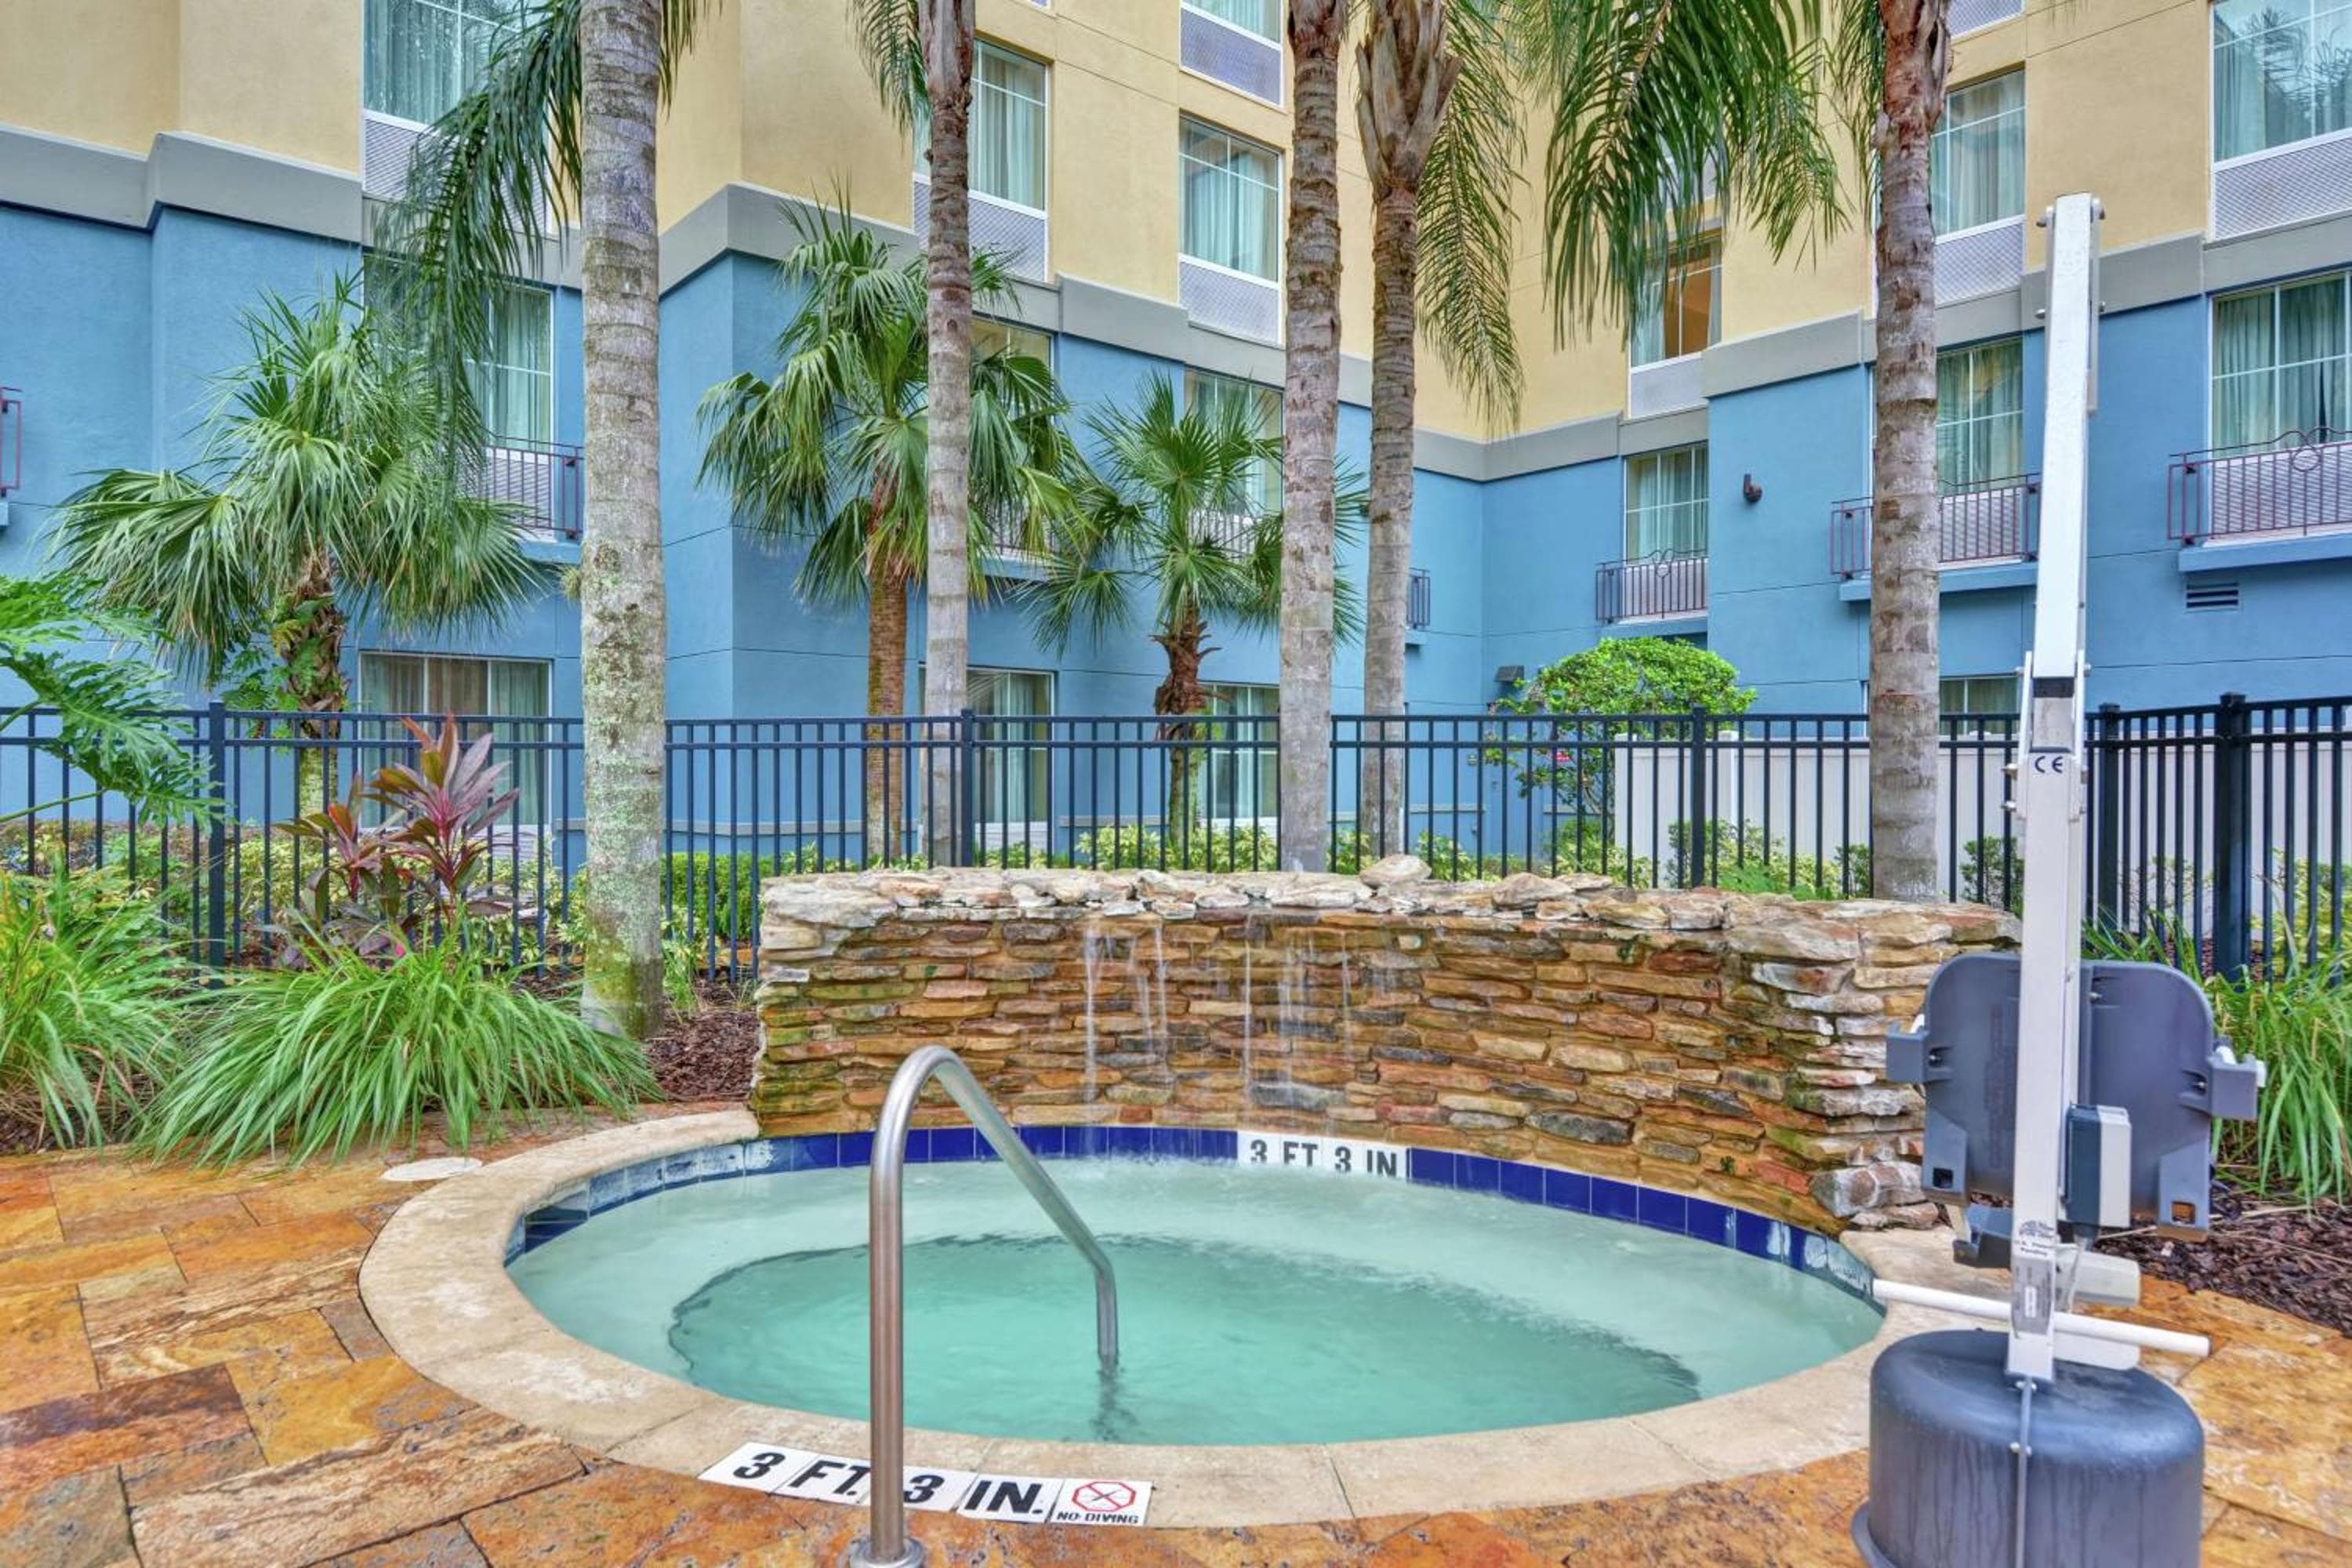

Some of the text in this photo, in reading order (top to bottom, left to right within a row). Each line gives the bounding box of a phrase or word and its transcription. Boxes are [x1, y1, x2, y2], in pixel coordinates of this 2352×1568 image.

[2034, 756, 2063, 773] CE
[1250, 1139, 1397, 1178] 3 FT 3 IN
[733, 1452, 1044, 1515] 3 FT. 3 IN.
[1056, 1511, 1139, 1523] NO DIVING
